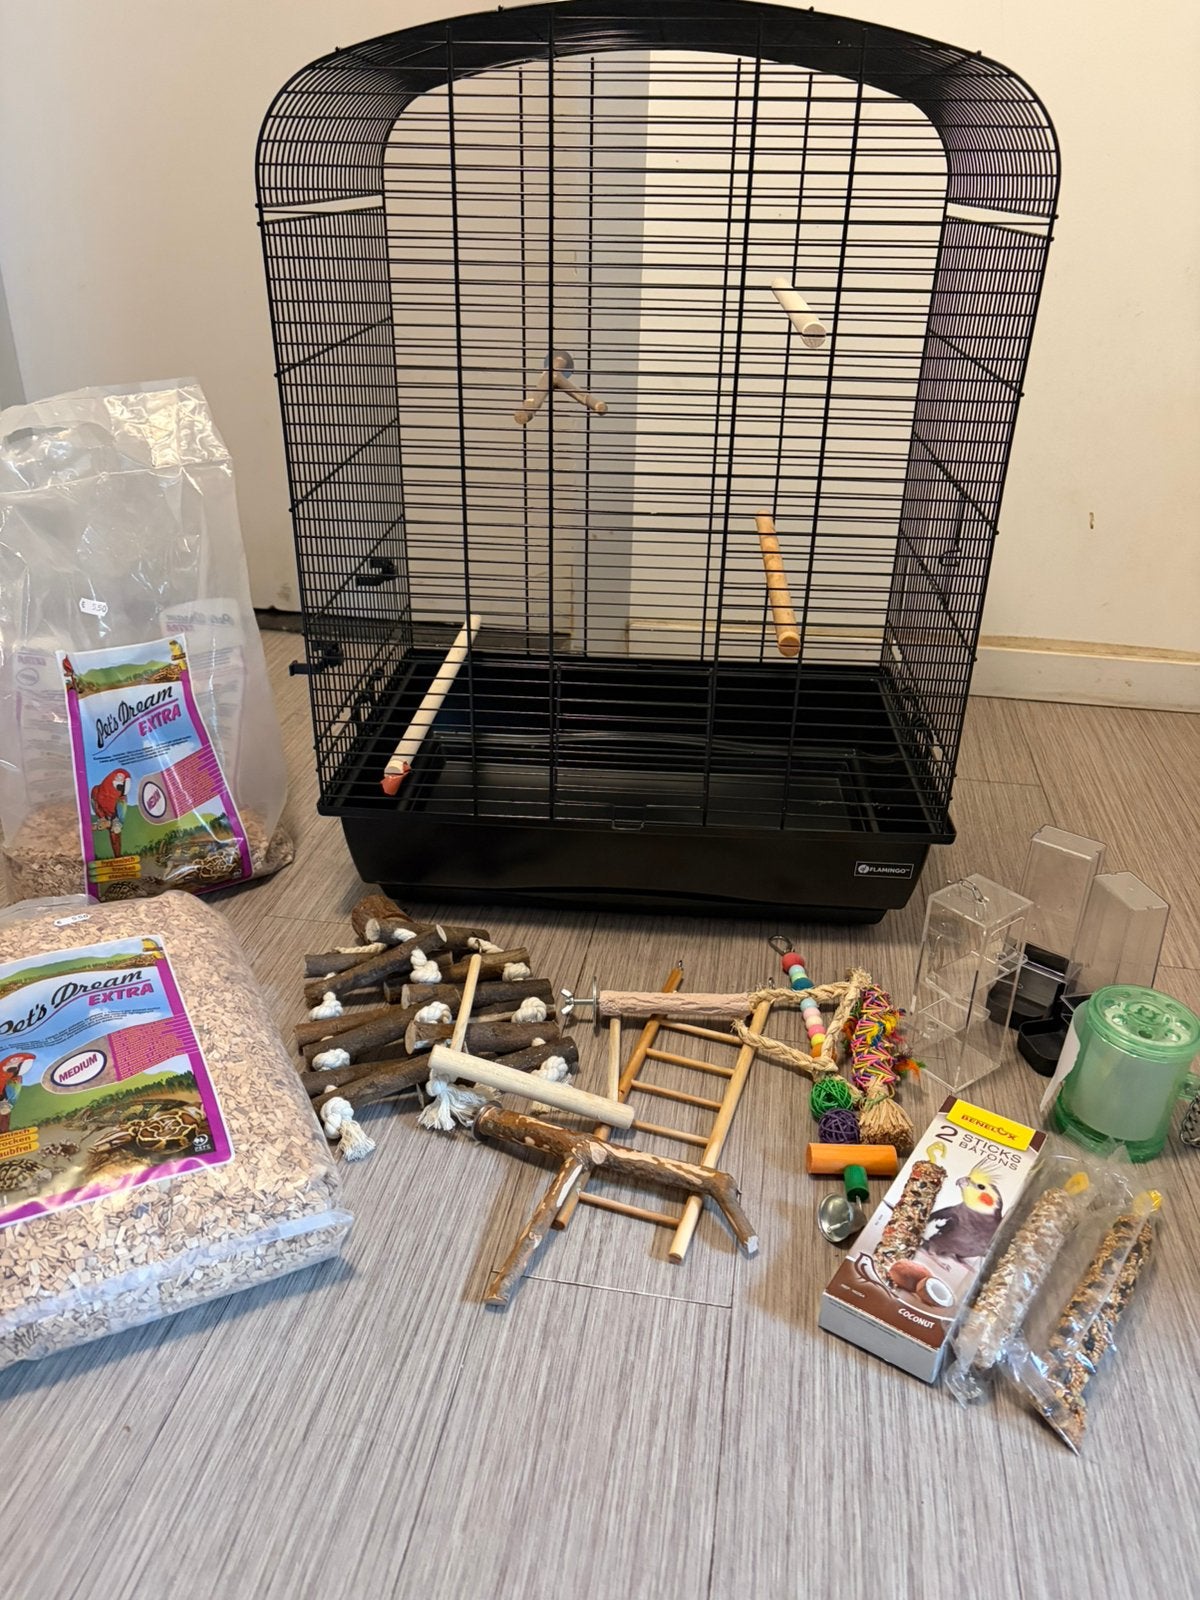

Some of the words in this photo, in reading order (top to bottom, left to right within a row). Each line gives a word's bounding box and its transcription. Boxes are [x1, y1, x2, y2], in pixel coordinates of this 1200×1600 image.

[96, 714, 119, 749] Pet's
[118, 686, 173, 727] Dream
[138, 703, 182, 737] EXTRA
[50, 970, 142, 1009] Dream
[88, 982, 154, 1007] EXTRA
[58, 1053, 98, 1083] MEDIUM
[961, 1114, 1018, 1141] BENELUX
[935, 1125, 959, 1144] 2
[962, 1133, 1022, 1165] STICKS
[898, 1308, 935, 1329] COCONUT
